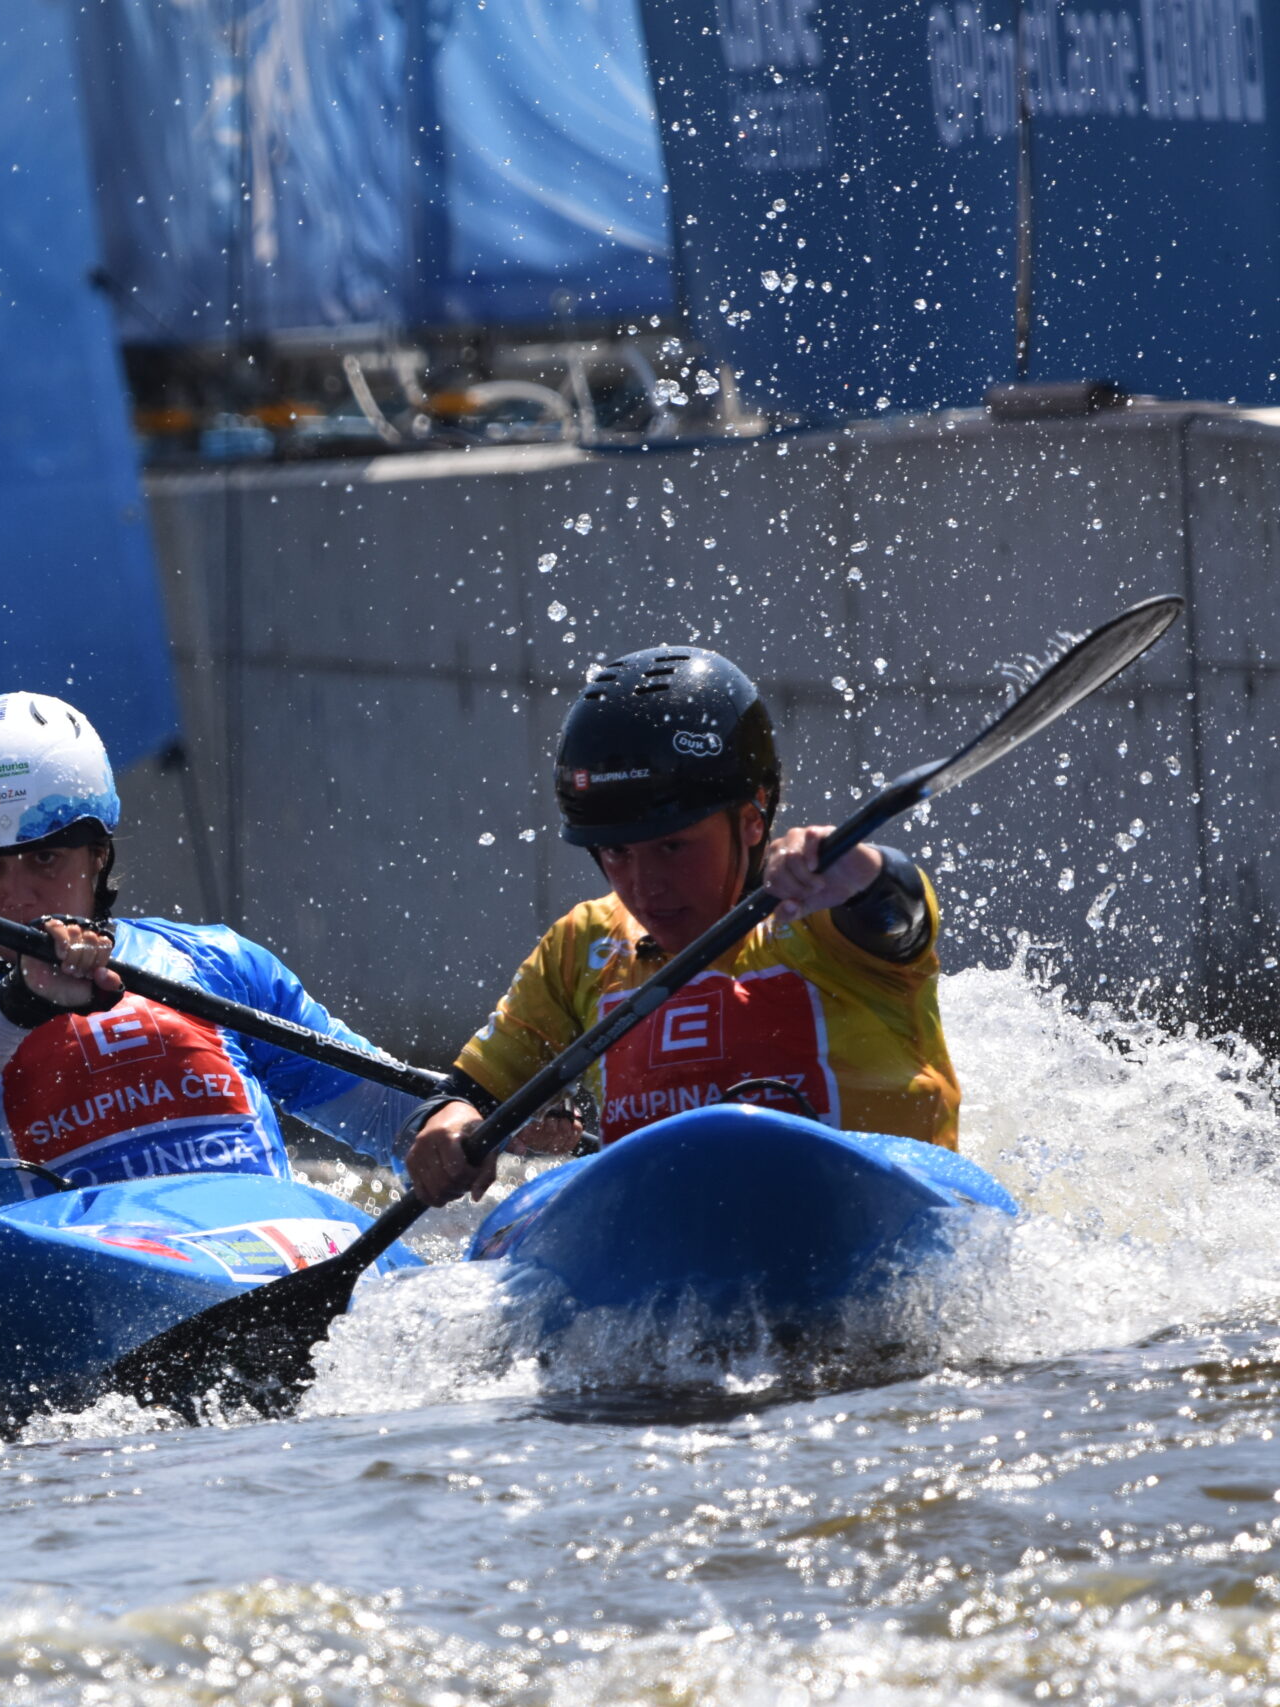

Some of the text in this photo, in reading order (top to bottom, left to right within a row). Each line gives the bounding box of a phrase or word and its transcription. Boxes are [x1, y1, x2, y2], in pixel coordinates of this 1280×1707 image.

[590, 768, 650, 783] SKUPINA ČEZ
[29, 1068, 236, 1145] SKUPINA ČEZ
[606, 1083, 724, 1124] SKUPINA
[121, 1136, 259, 1179] UNIQA
